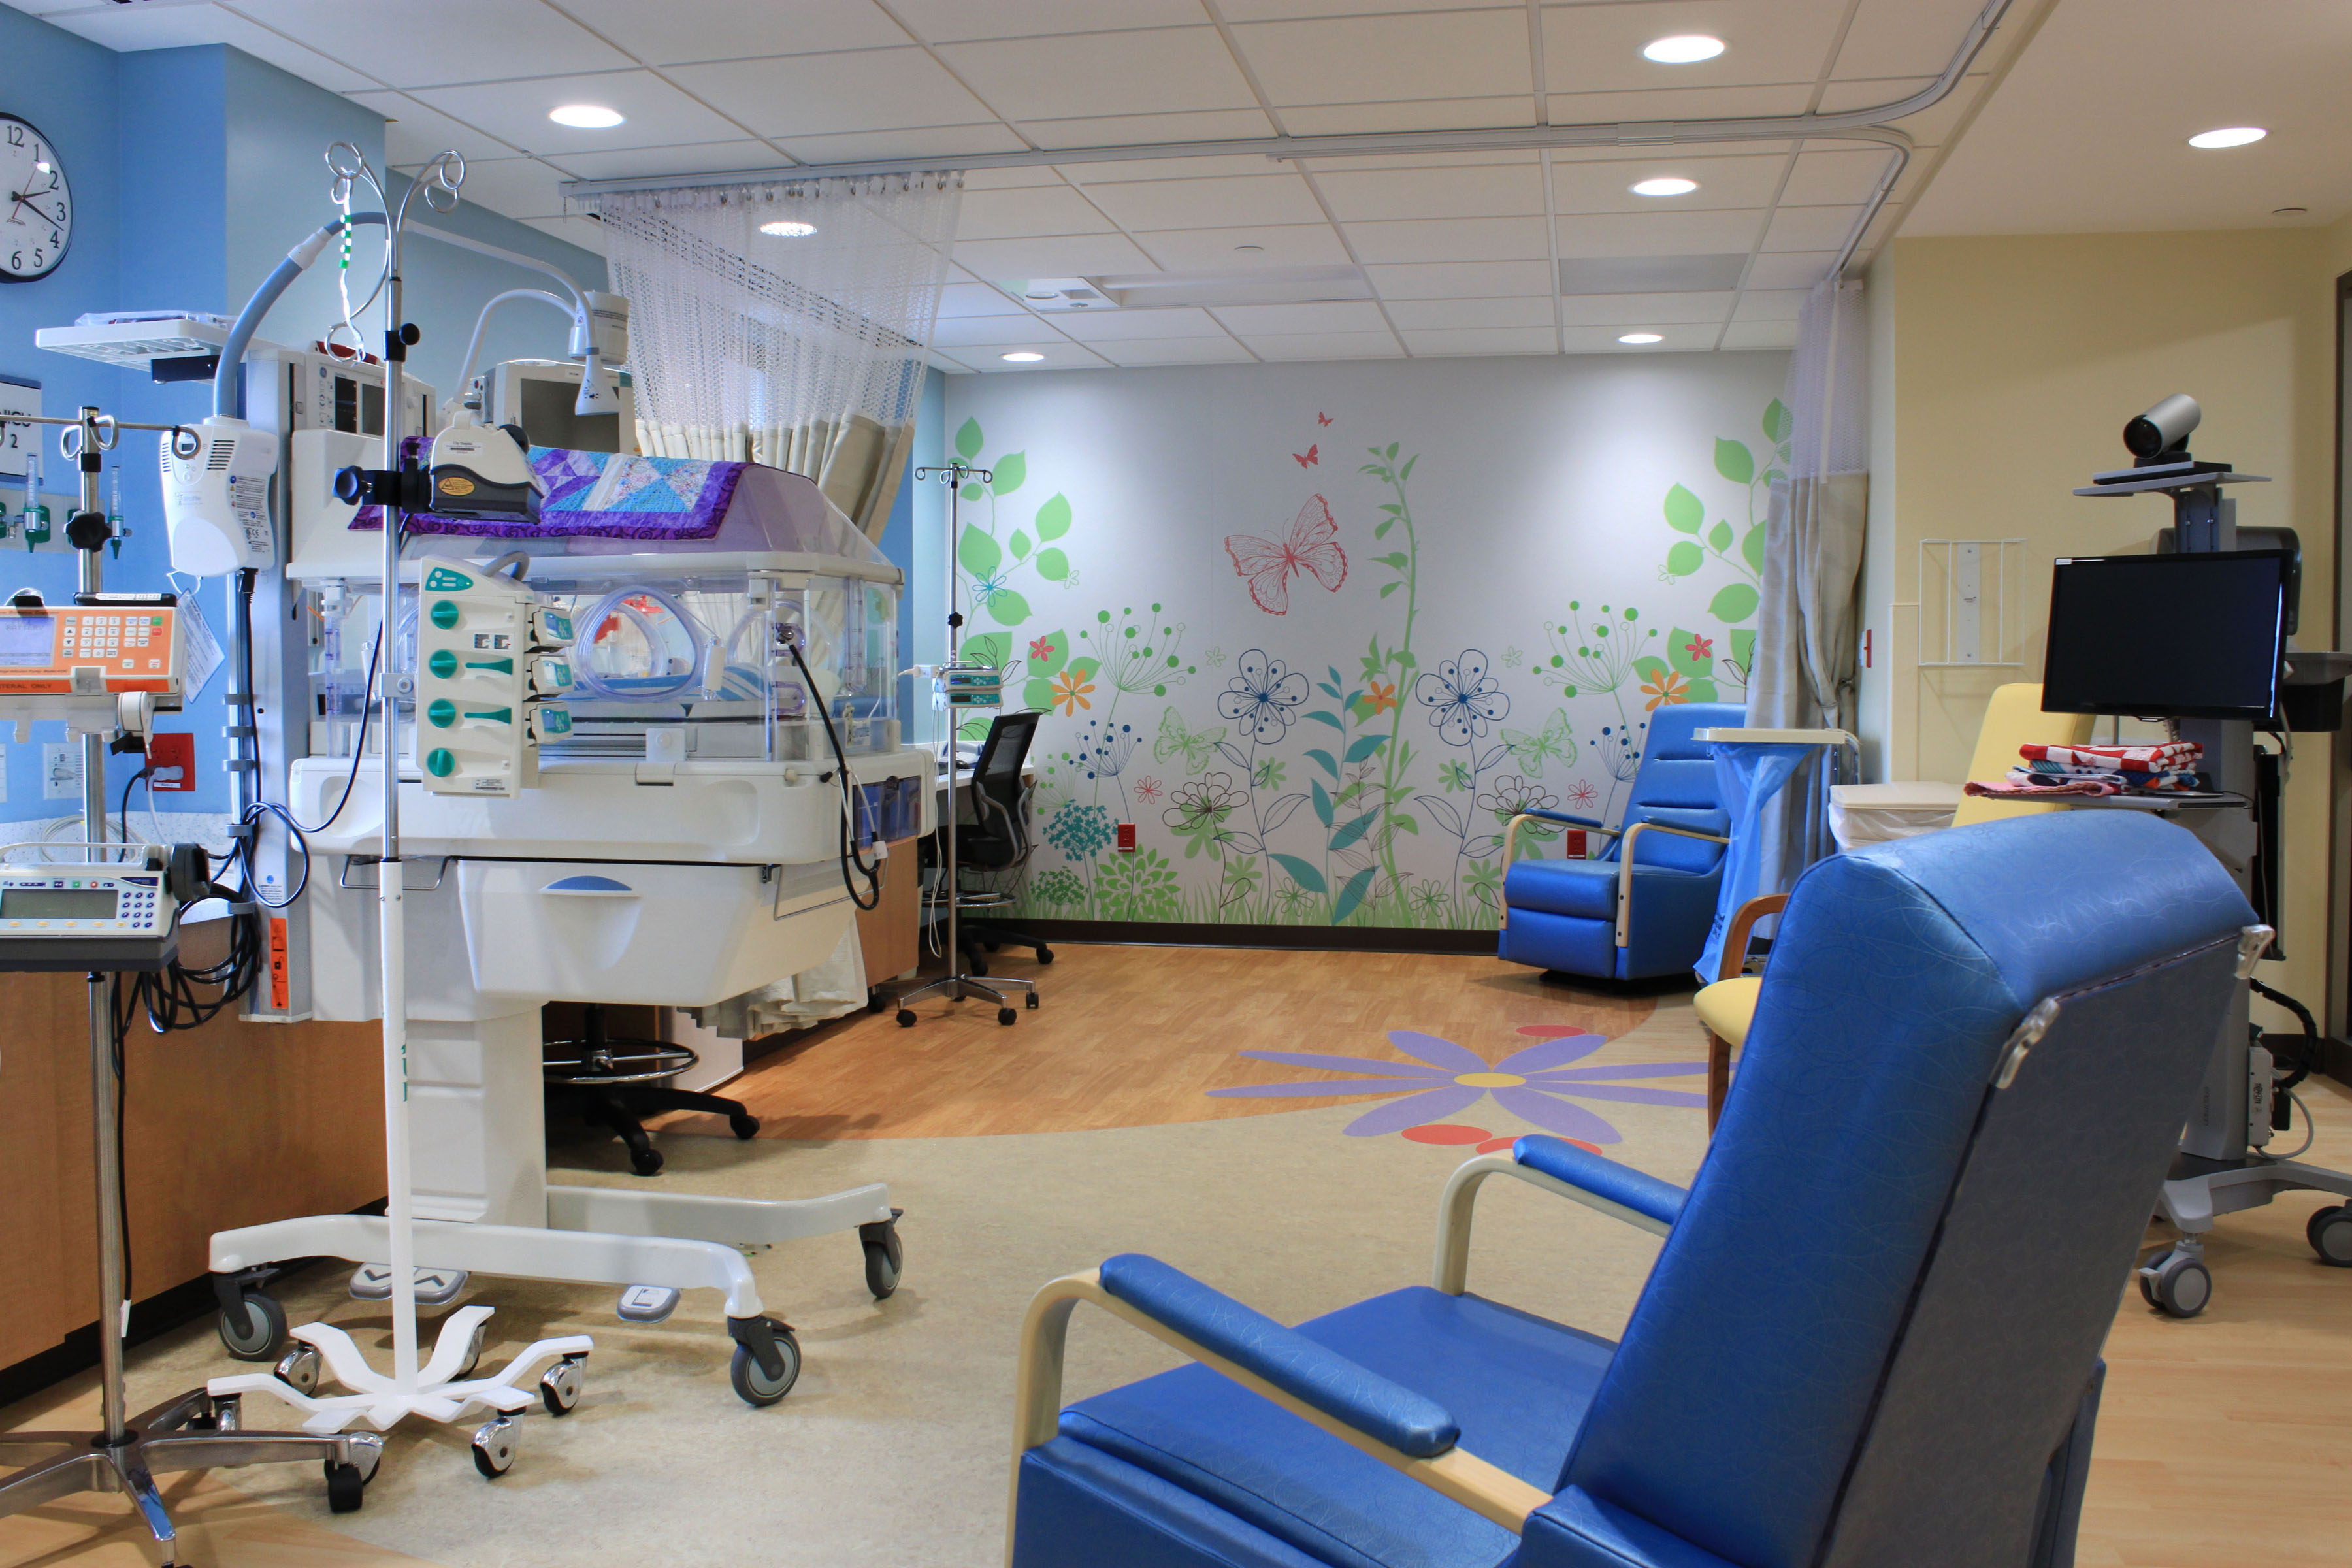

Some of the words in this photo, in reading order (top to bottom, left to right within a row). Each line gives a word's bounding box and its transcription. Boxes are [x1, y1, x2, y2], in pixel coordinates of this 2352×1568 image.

[7, 125, 25, 148] 12
[33, 143, 41, 163] 1
[49, 170, 59, 191] 2
[57, 201, 66, 221] 3
[50, 230, 60, 249] 4
[12, 250, 22, 270] 6
[34, 248, 43, 268] 5
[10, 433, 18, 448] 2
